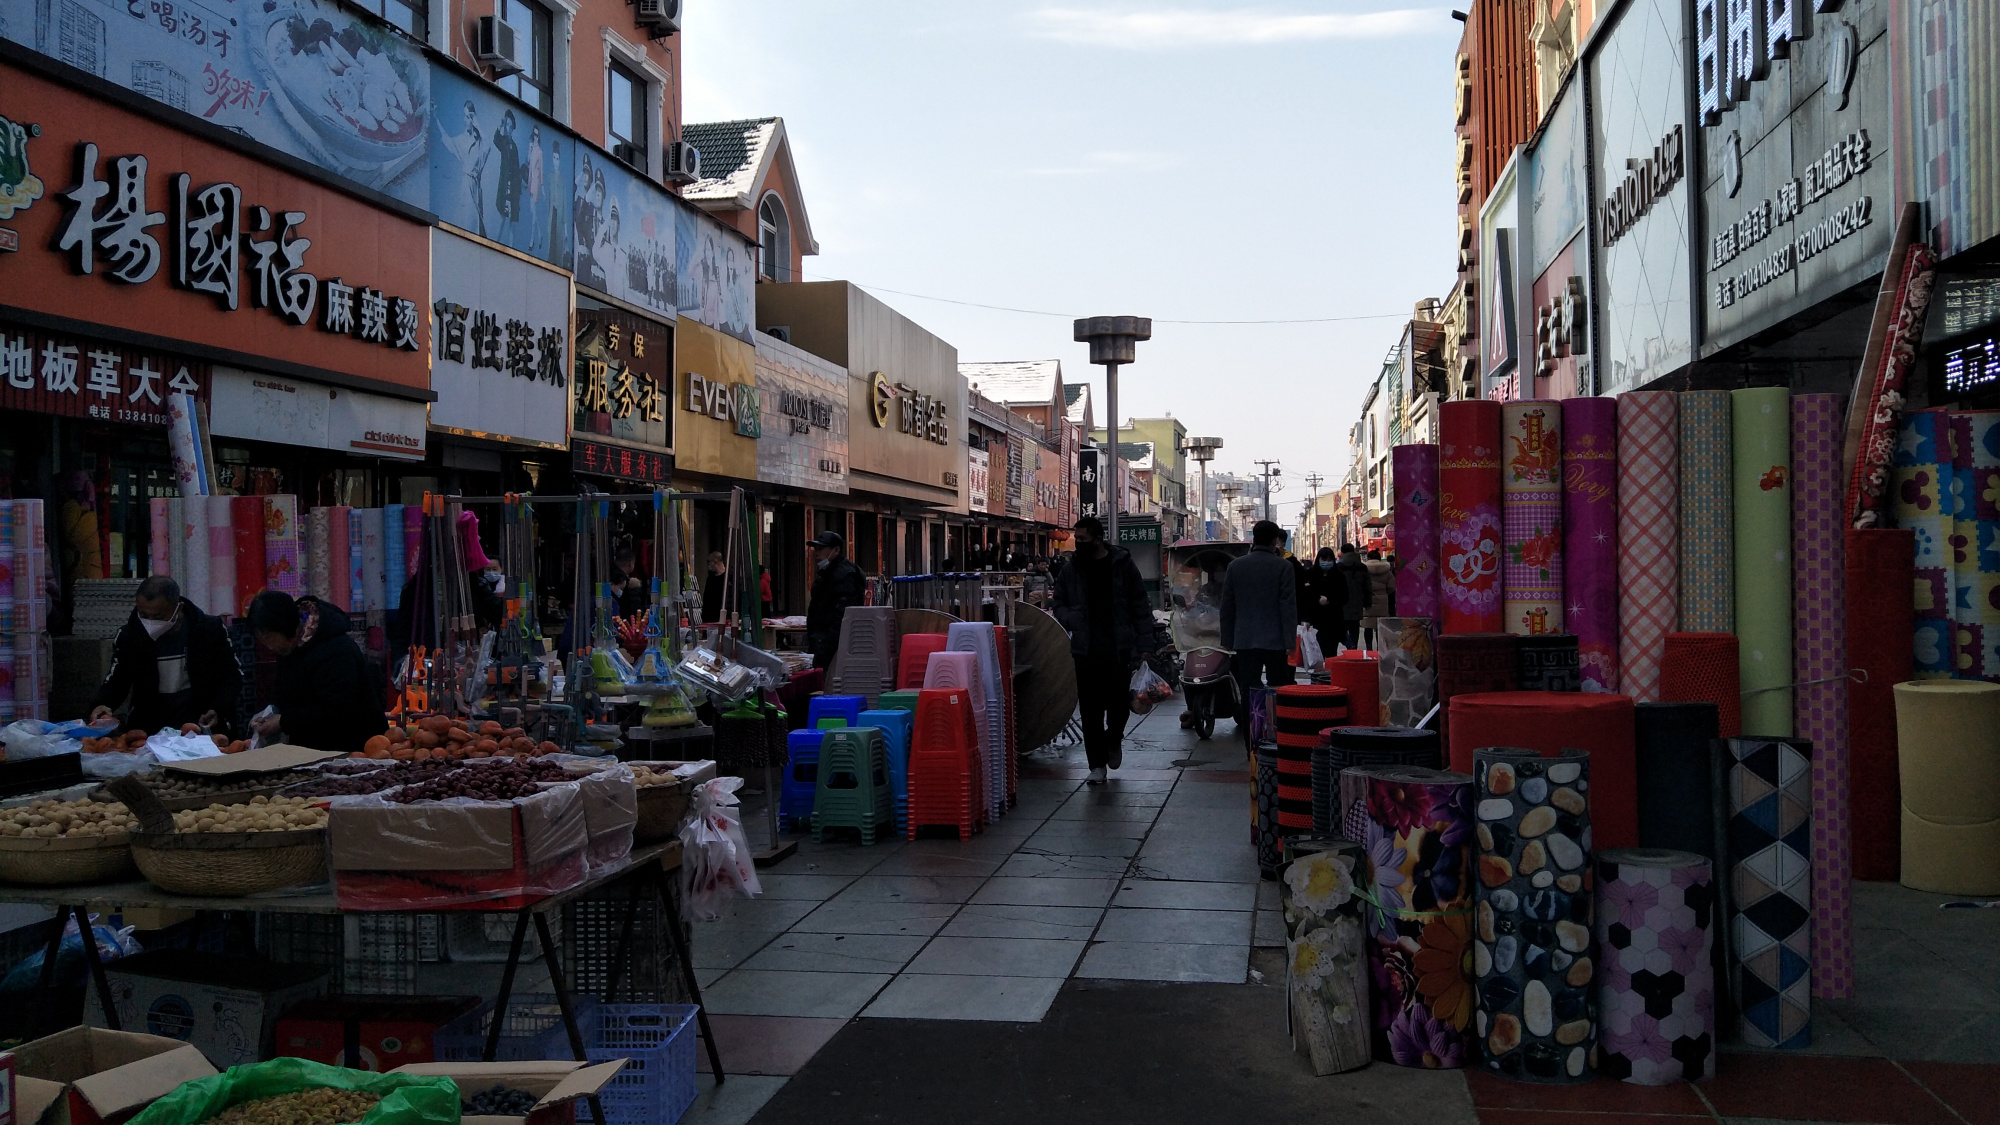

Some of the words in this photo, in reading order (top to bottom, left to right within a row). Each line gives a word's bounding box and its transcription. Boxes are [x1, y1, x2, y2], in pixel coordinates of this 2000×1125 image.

[1711, 223, 1741, 272] 儿童玩具
[1739, 199, 1771, 252] 日杂百货
[1774, 178, 1802, 228] 小家电
[1806, 128, 1871, 205] 厨卫用品大全
[1715, 278, 1735, 309] 电话
[1736, 243, 1792, 299] 13704104837
[1795, 196, 1870, 263] 13700108242
[322, 278, 420, 352] 麻辣烫
[434, 298, 565, 388] 佰姓鞋城
[606, 323, 645, 359] 劳保
[0, 333, 199, 406] 地板革大全
[583, 359, 664, 423] 服务社
[687, 373, 738, 422] EVEN
[89, 404, 110, 420] 电话
[901, 383, 949, 446] 丽都名品
[584, 444, 663, 480] 军人服务社
[1081, 465, 1097, 518] 南洋
[1564, 463, 1611, 504] Very
